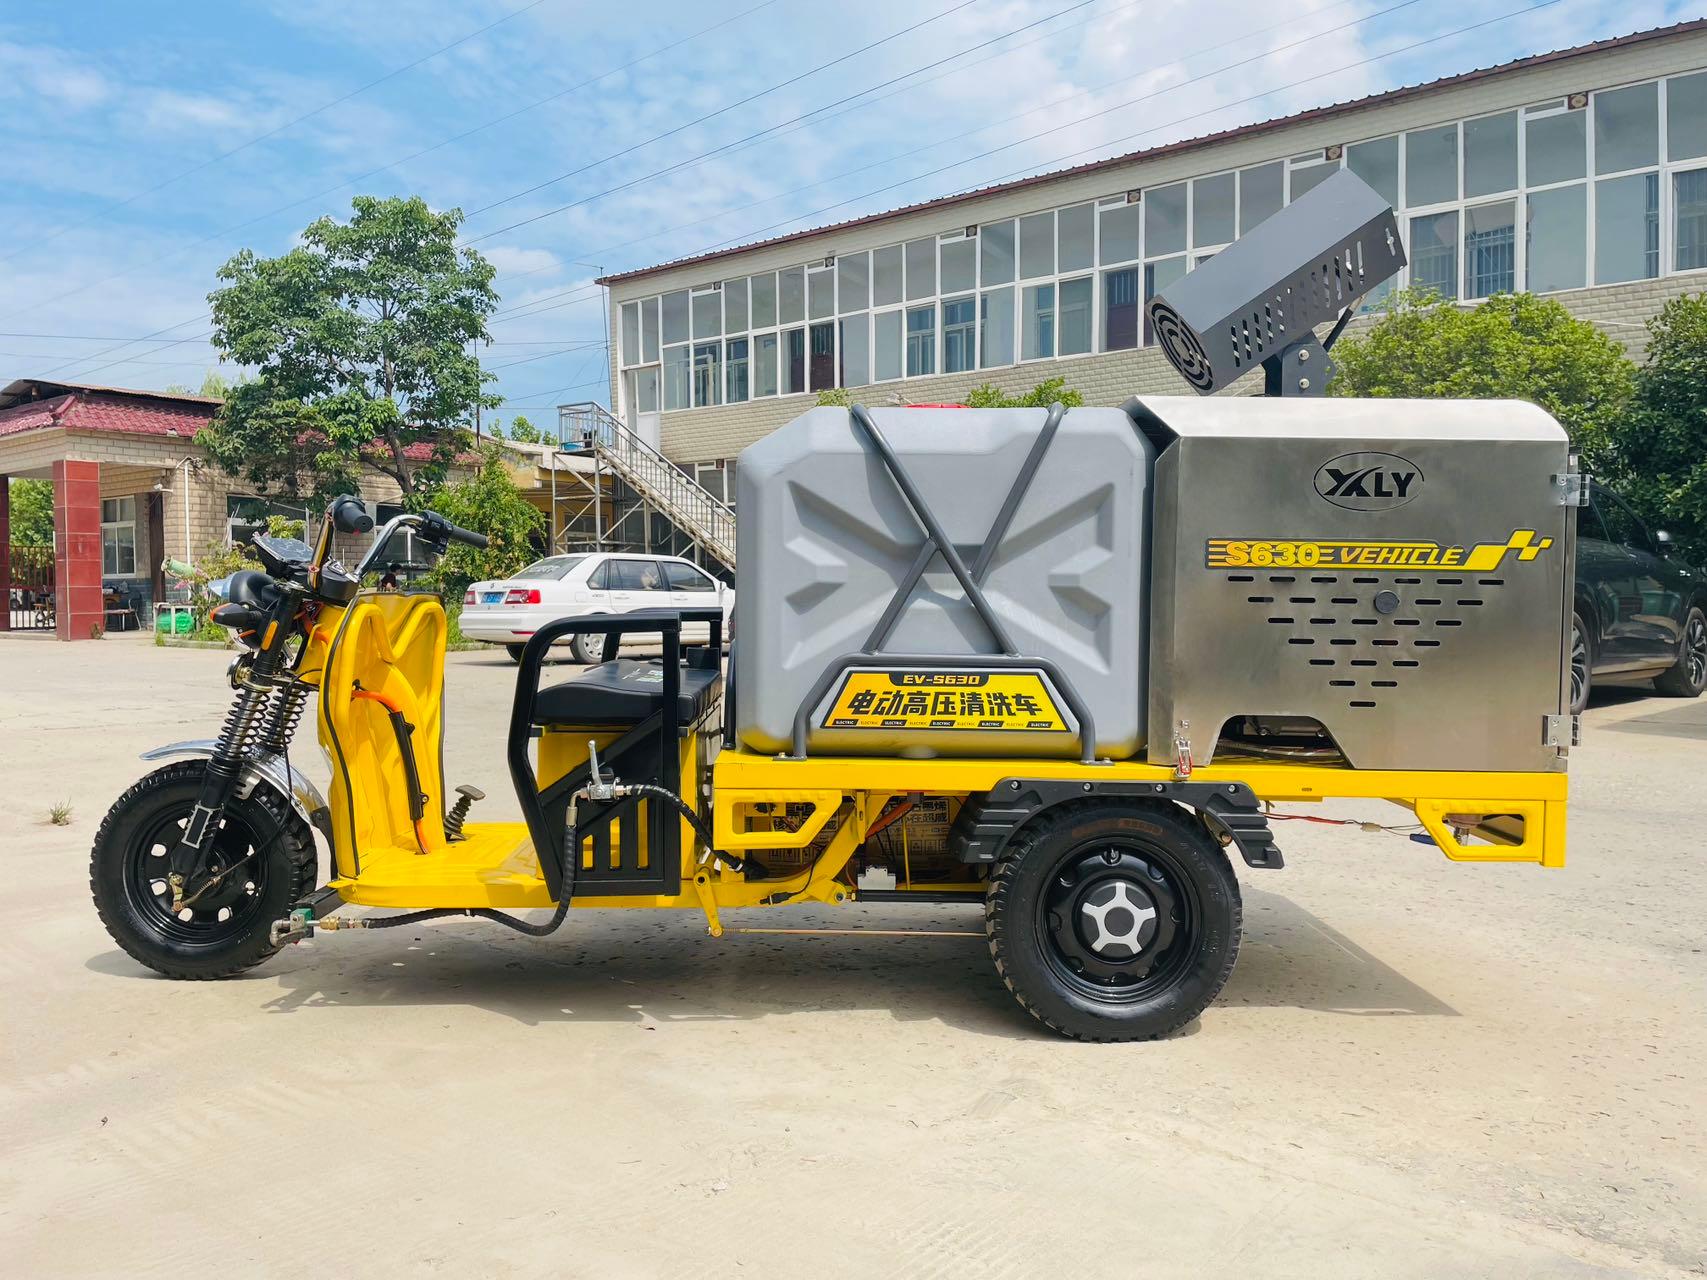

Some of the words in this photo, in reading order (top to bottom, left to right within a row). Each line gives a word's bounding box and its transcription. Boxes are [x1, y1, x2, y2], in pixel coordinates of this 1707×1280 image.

[1224, 541, 1321, 567] S630
[1340, 547, 1465, 565] VEHICLE
[903, 675, 980, 685] EV-S630
[847, 689, 1043, 716] 电动高压清洗车
